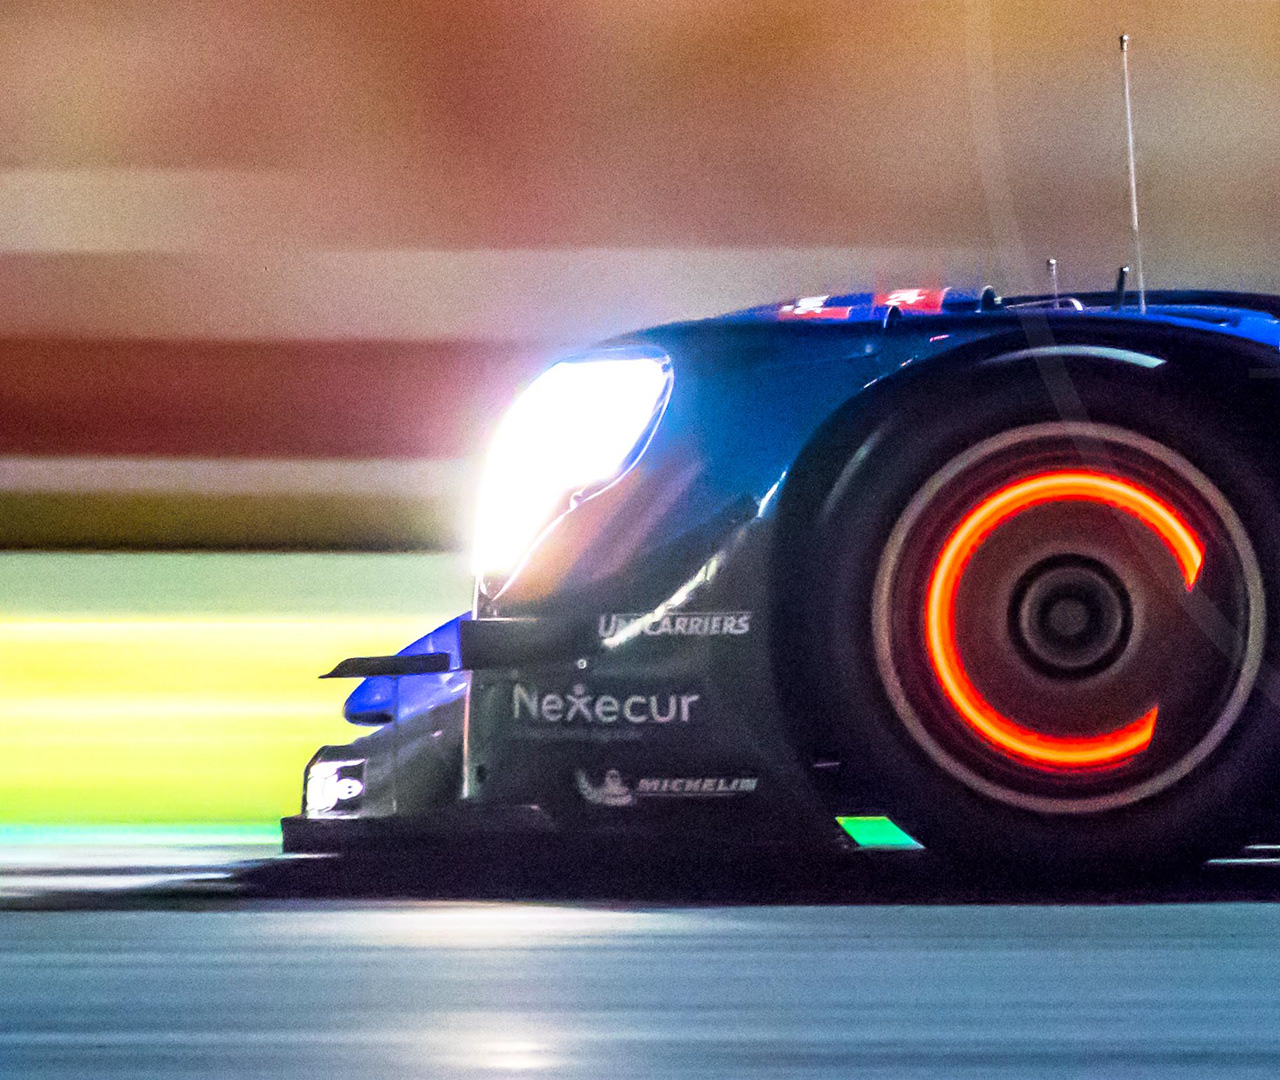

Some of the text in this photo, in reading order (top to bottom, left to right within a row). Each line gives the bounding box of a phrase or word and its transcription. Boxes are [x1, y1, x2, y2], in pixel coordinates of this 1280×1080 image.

[598, 613, 752, 638] UCARRIERS
[513, 683, 700, 724] Nexecur
[637, 777, 759, 794] MICHELIN
